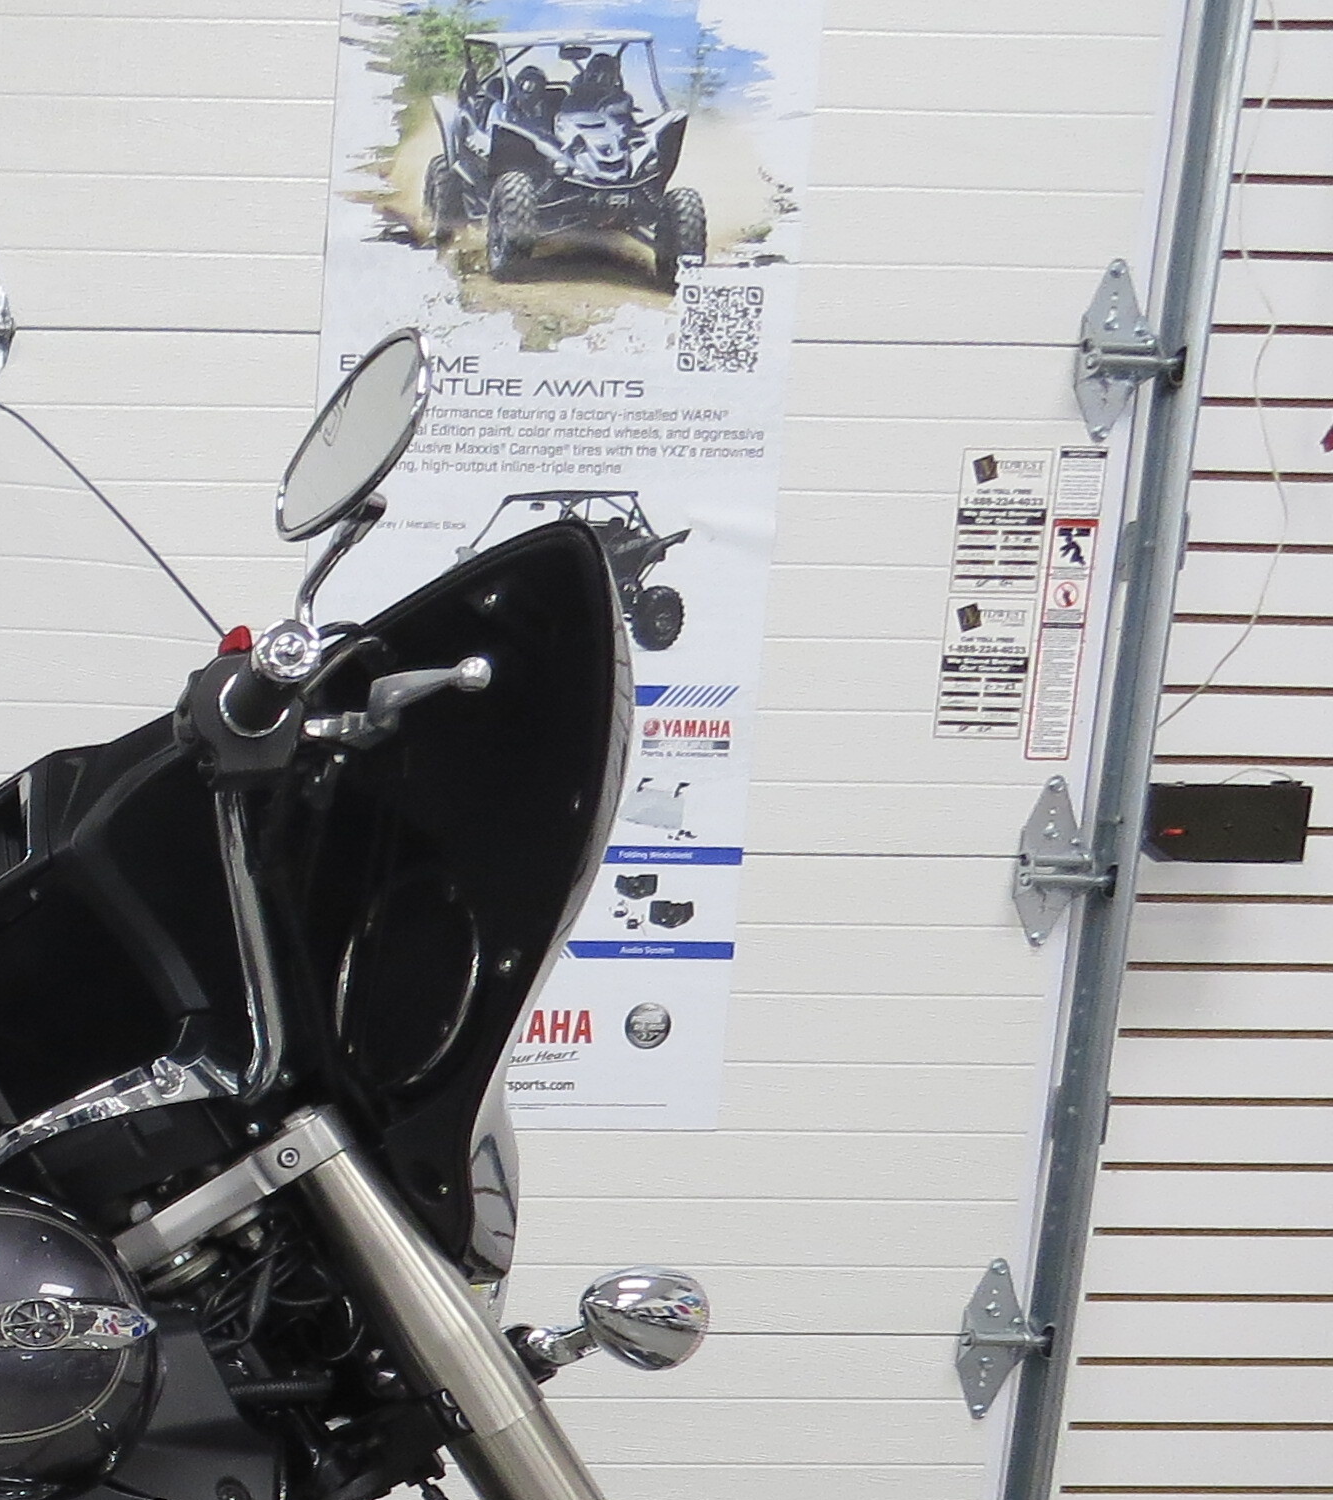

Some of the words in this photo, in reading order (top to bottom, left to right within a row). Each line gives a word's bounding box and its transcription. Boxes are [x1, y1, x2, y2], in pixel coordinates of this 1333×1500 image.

[533, 380, 645, 398] AWAITS
[497, 407, 556, 422] featuring
[559, 411, 567, 420] a
[571, 408, 678, 422] factory-installed
[432, 424, 475, 437] Edition
[518, 426, 553, 438] color
[554, 426, 611, 439] matched
[666, 428, 690, 440] and
[694, 428, 764, 442] aggressive
[573, 444, 602, 457] tires
[606, 445, 633, 457] with
[637, 445, 657, 457] the
[700, 446, 764, 458] renowned
[421, 460, 497, 474] high-output
[501, 460, 574, 474] inline-triple
[663, 719, 731, 738] YAMAHA
[618, 850, 648, 860] Folding
[618, 946, 644, 955] Audio
[645, 946, 675, 956] System
[536, 1050, 580, 1062] Heart
